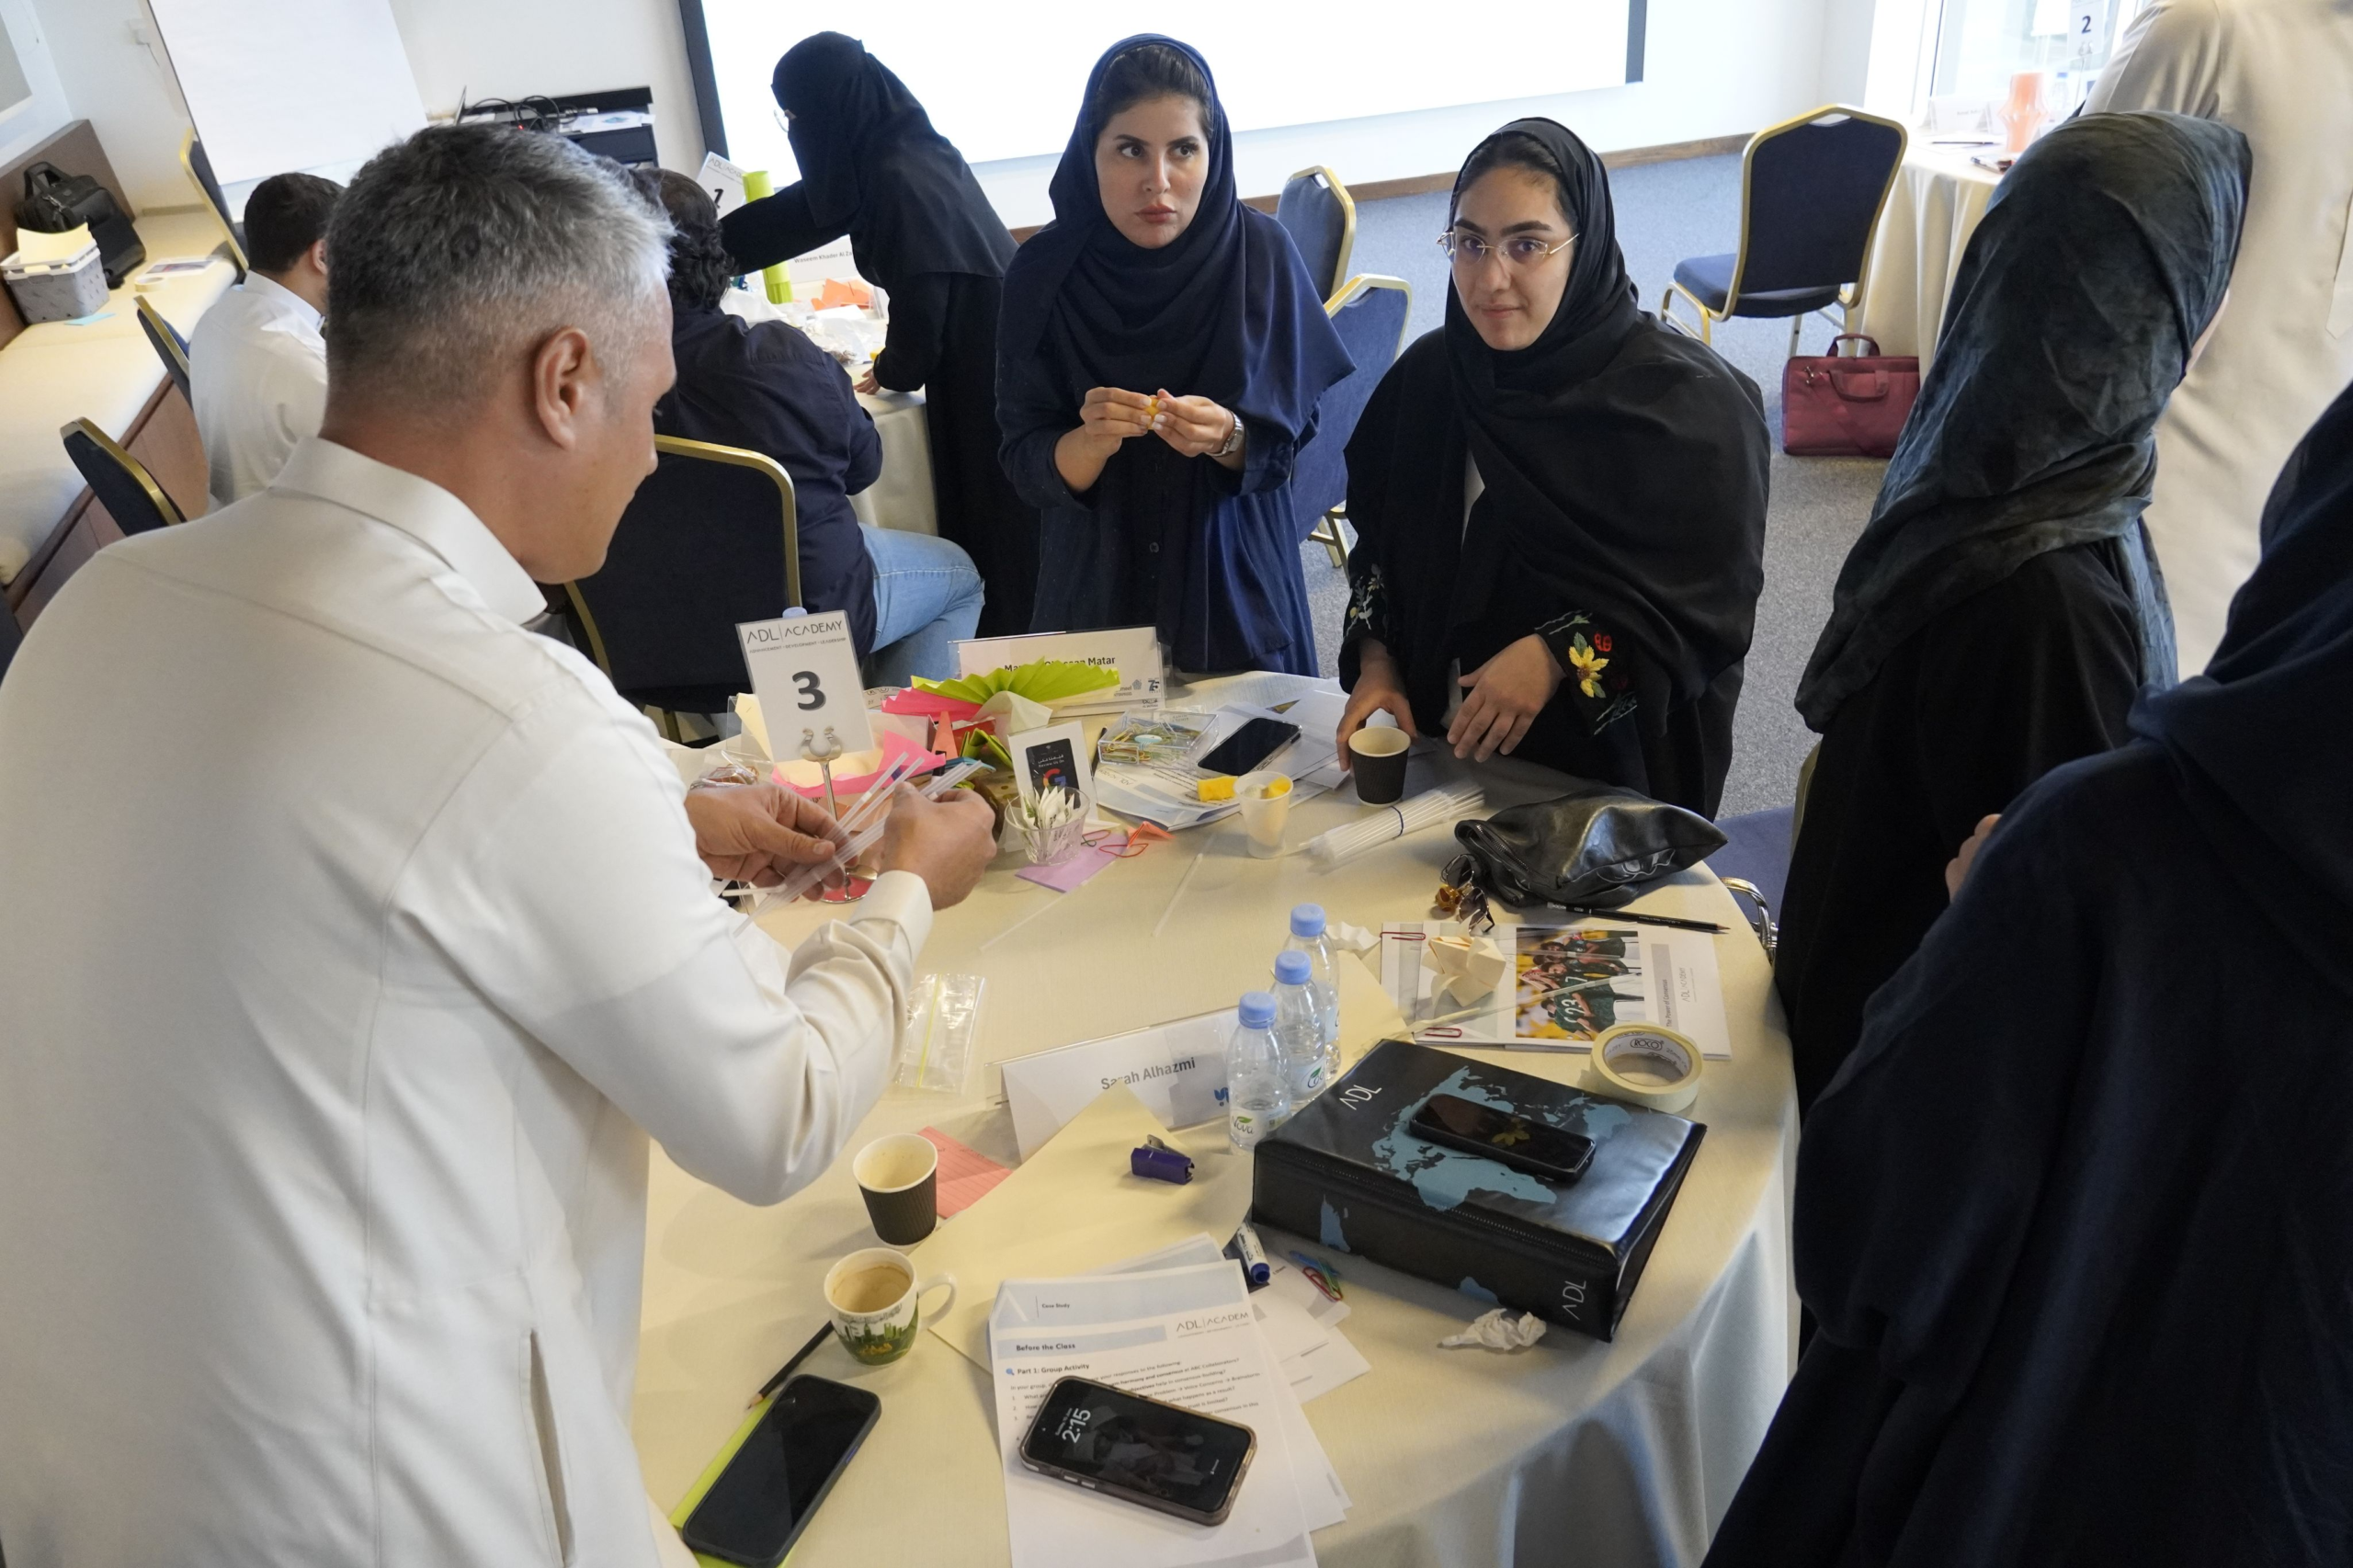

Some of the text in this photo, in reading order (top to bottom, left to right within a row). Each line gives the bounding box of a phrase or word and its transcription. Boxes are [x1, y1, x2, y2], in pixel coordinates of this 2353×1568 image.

[2081, 15, 2091, 34] 2
[714, 188, 724, 209] 1
[747, 620, 842, 644] ADL ACADEMY
[785, 641, 817, 649] DEVELOPMENT
[1087, 655, 1116, 666] Matar
[791, 671, 826, 711] 3
[1662, 979, 1670, 1000] Consensus
[1633, 1040, 1660, 1049] ROCO
[1100, 1057, 1196, 1090] Saah Alhazmi
[1339, 1085, 1382, 1110] ADL
[1231, 1116, 1255, 1135] Nova
[1563, 1280, 1586, 1321] ADL
[1176, 1319, 1203, 1333] ADL
[1041, 1366, 1063, 1374] Group
[1064, 1363, 1090, 1371] Activity
[1062, 1408, 1091, 1443] 2:15
